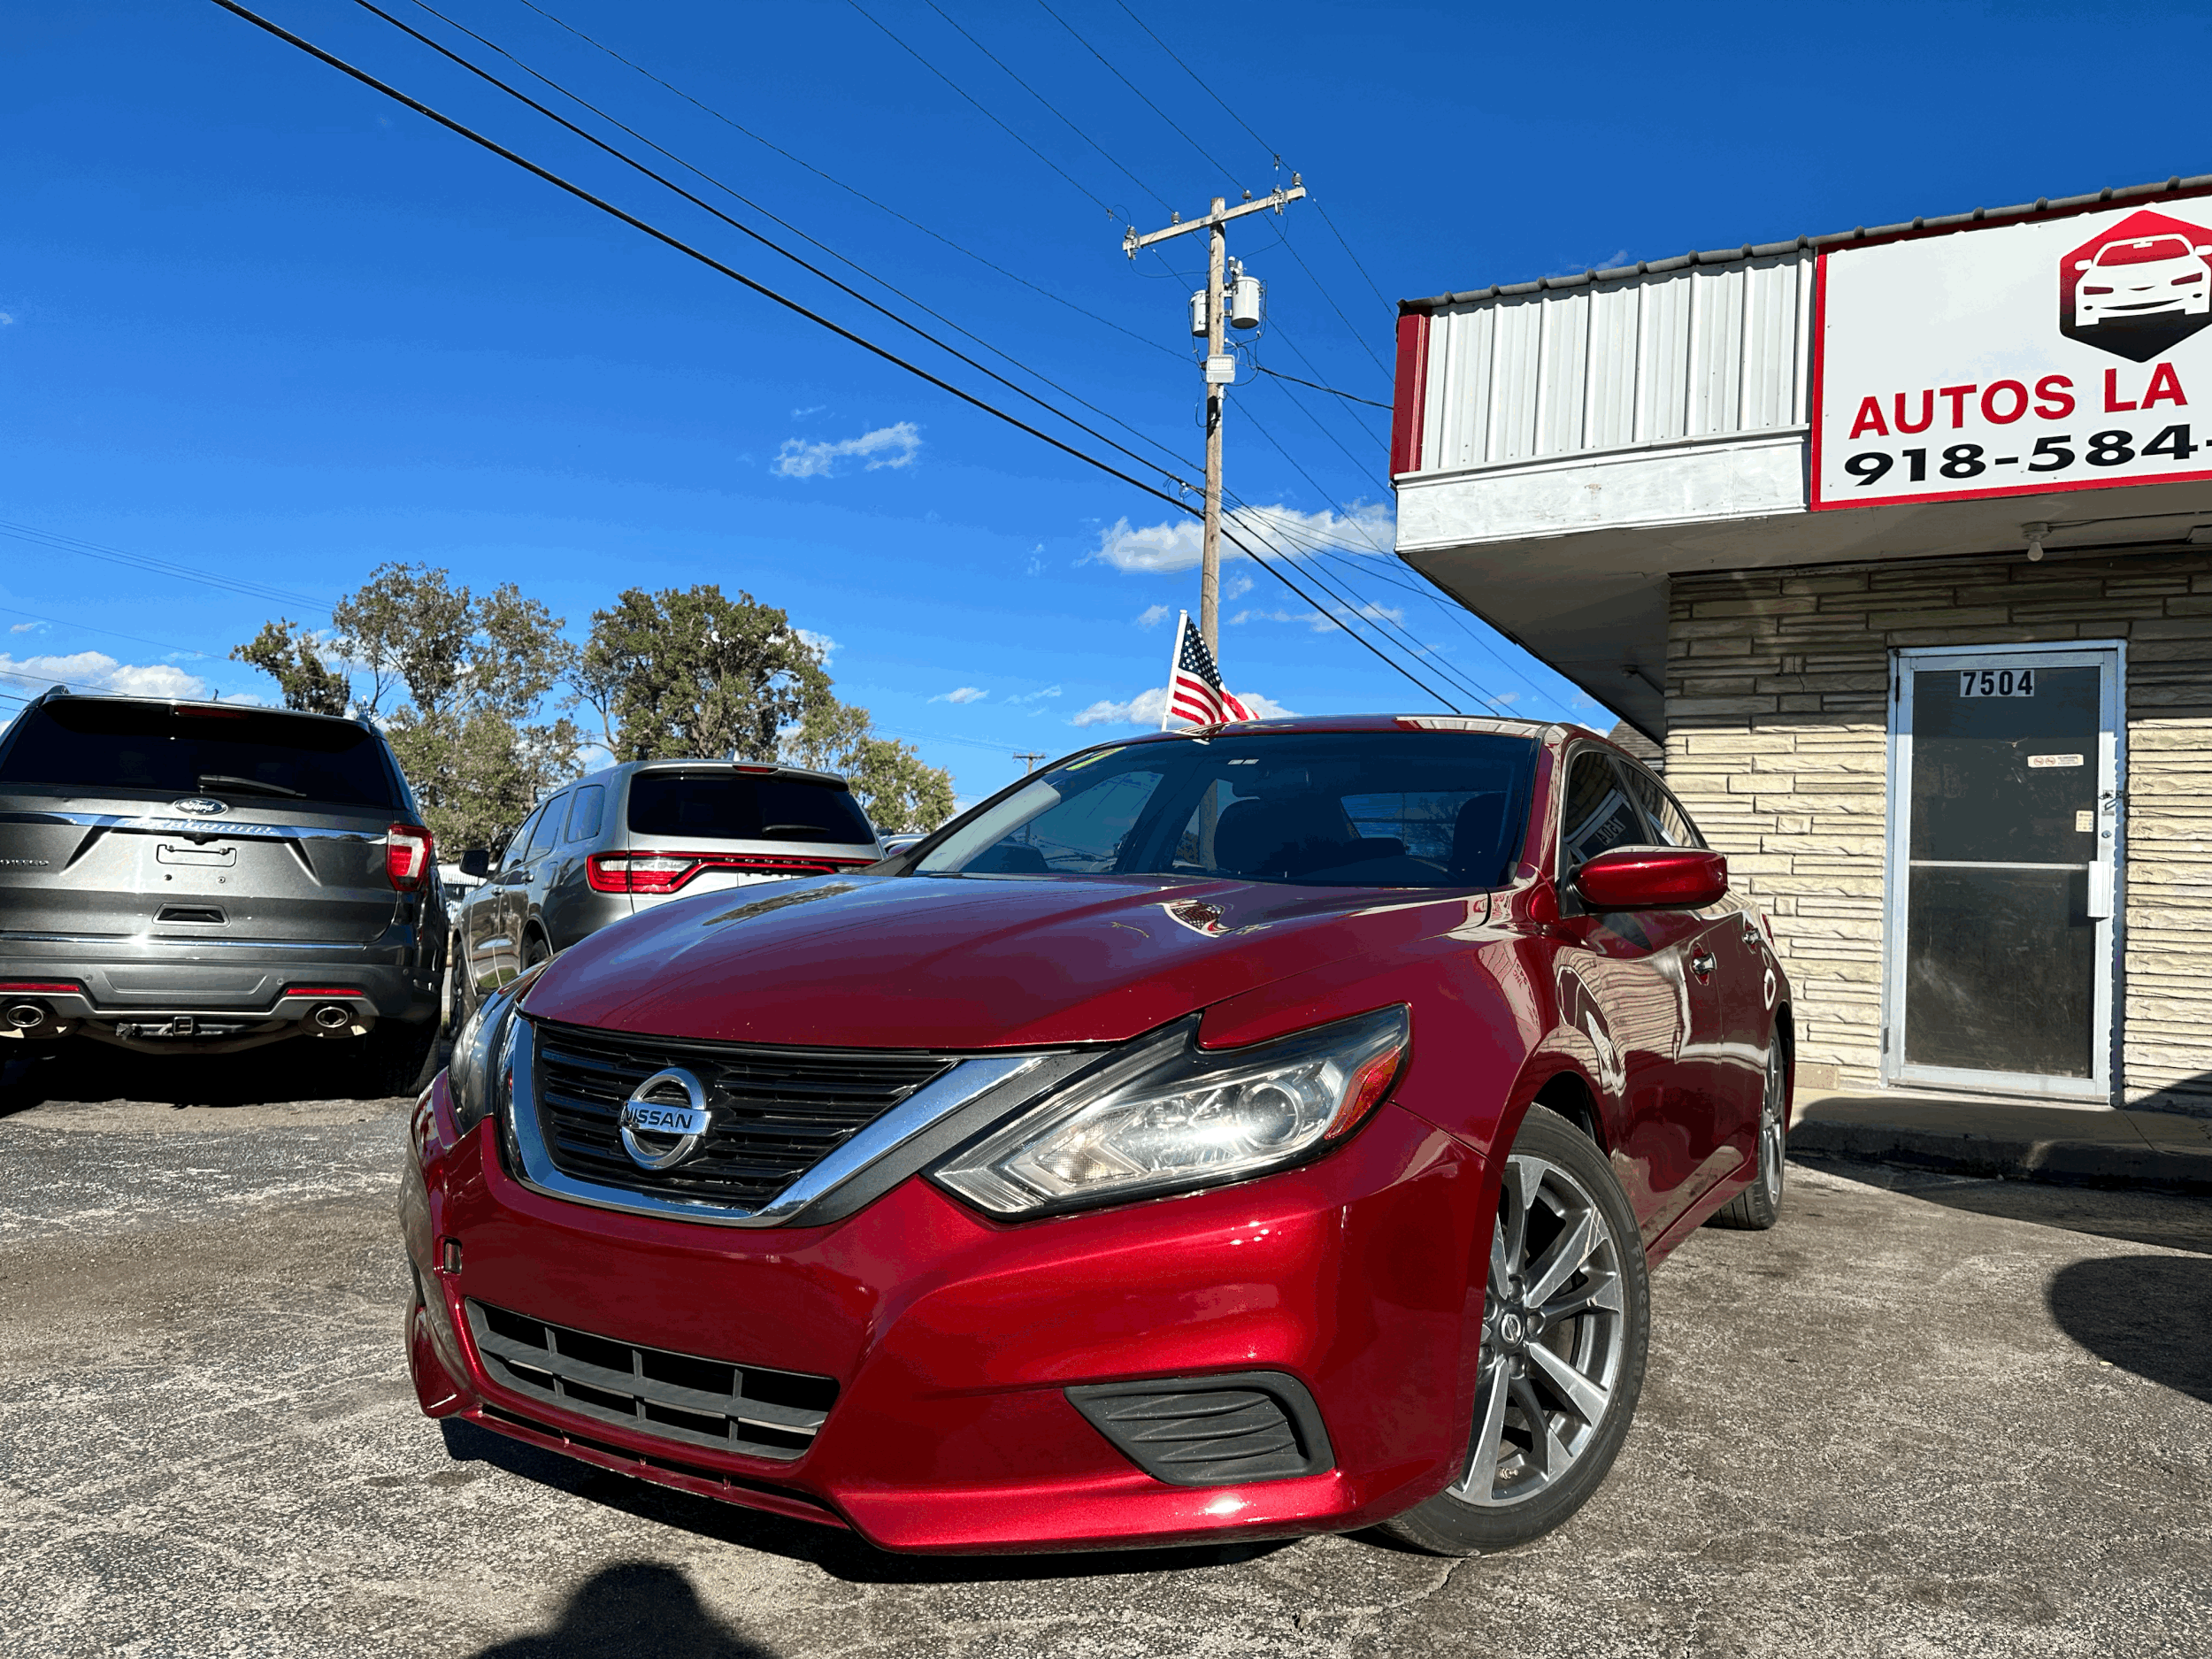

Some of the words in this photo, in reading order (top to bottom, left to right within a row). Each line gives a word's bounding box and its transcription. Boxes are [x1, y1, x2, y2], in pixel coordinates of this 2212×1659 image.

[1848, 374, 2076, 440] AUTOS
[2104, 362, 2189, 413] LA
[1844, 423, 2212, 486] 918-584
[1962, 670, 2033, 696] 7504
[624, 1102, 693, 1129] NISSAN
[1631, 1240, 1648, 1397] Firestone
